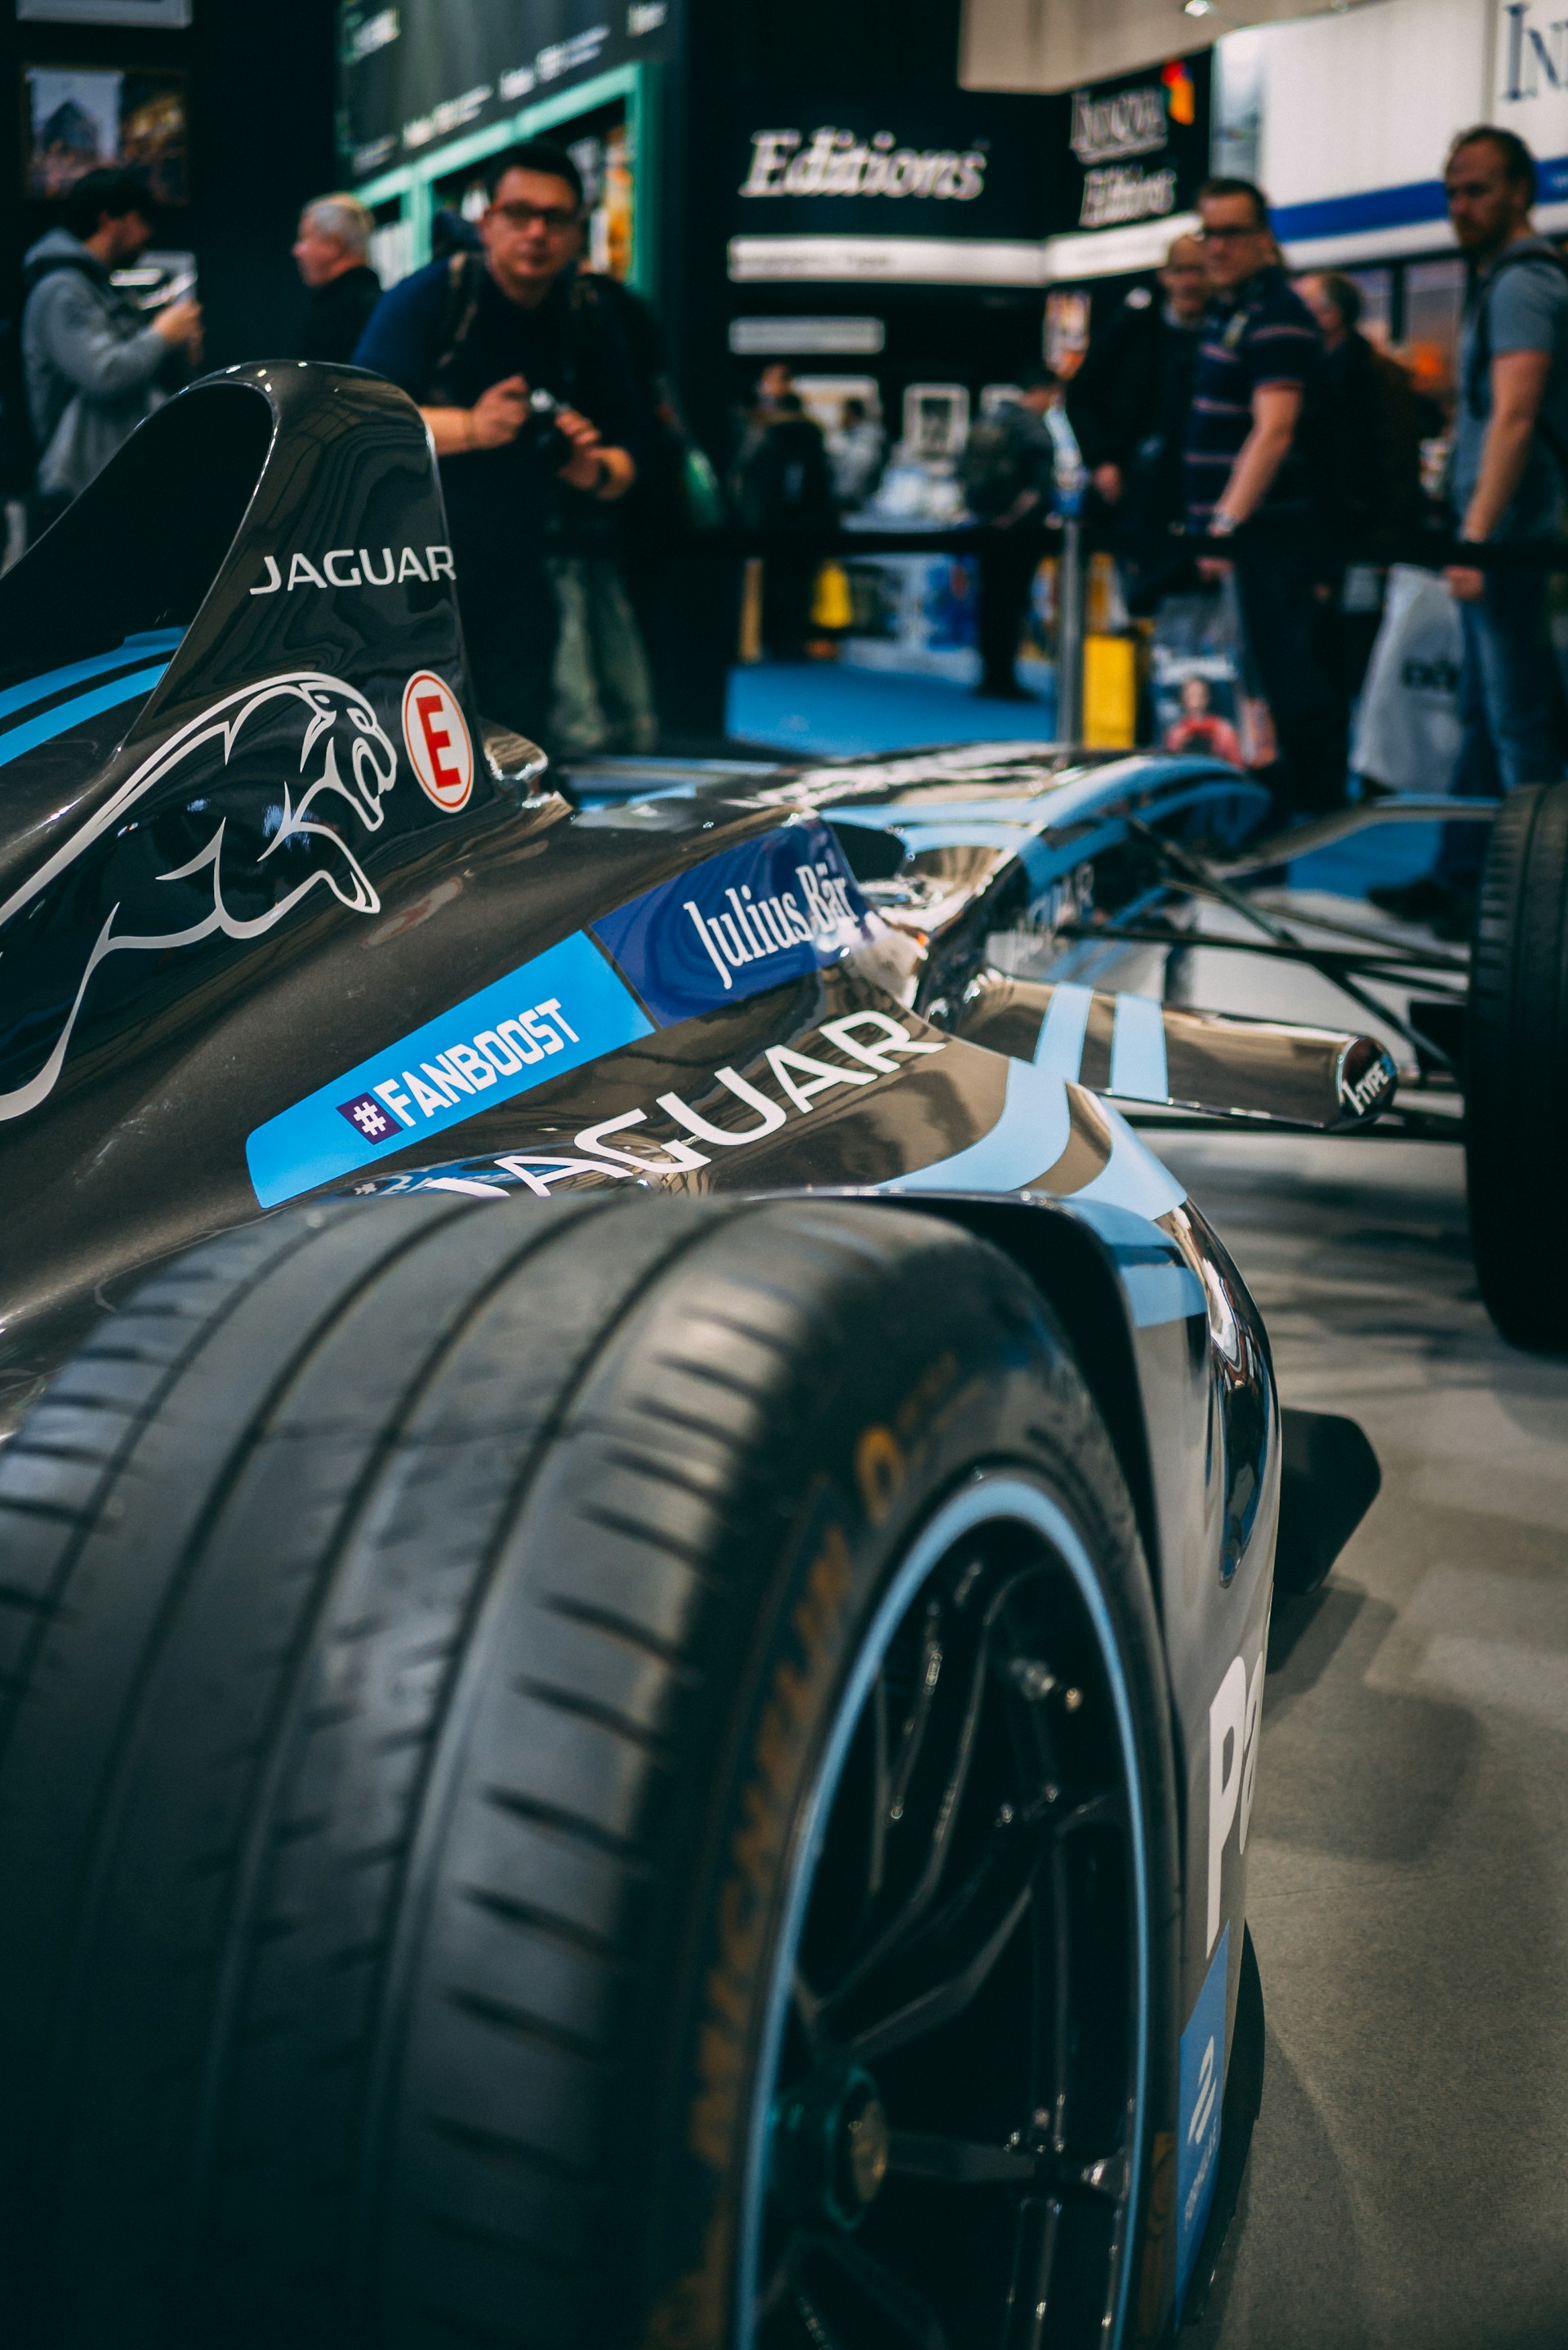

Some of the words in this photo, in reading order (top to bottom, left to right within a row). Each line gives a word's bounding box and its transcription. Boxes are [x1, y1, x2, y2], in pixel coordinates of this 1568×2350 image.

[738, 126, 987, 201] Editions
[249, 546, 457, 595] JAGUAR
[416, 694, 462, 790] E
[683, 884, 814, 991] Julius
[795, 862, 861, 933] Bär
[353, 997, 581, 1136] #FANBOOST
